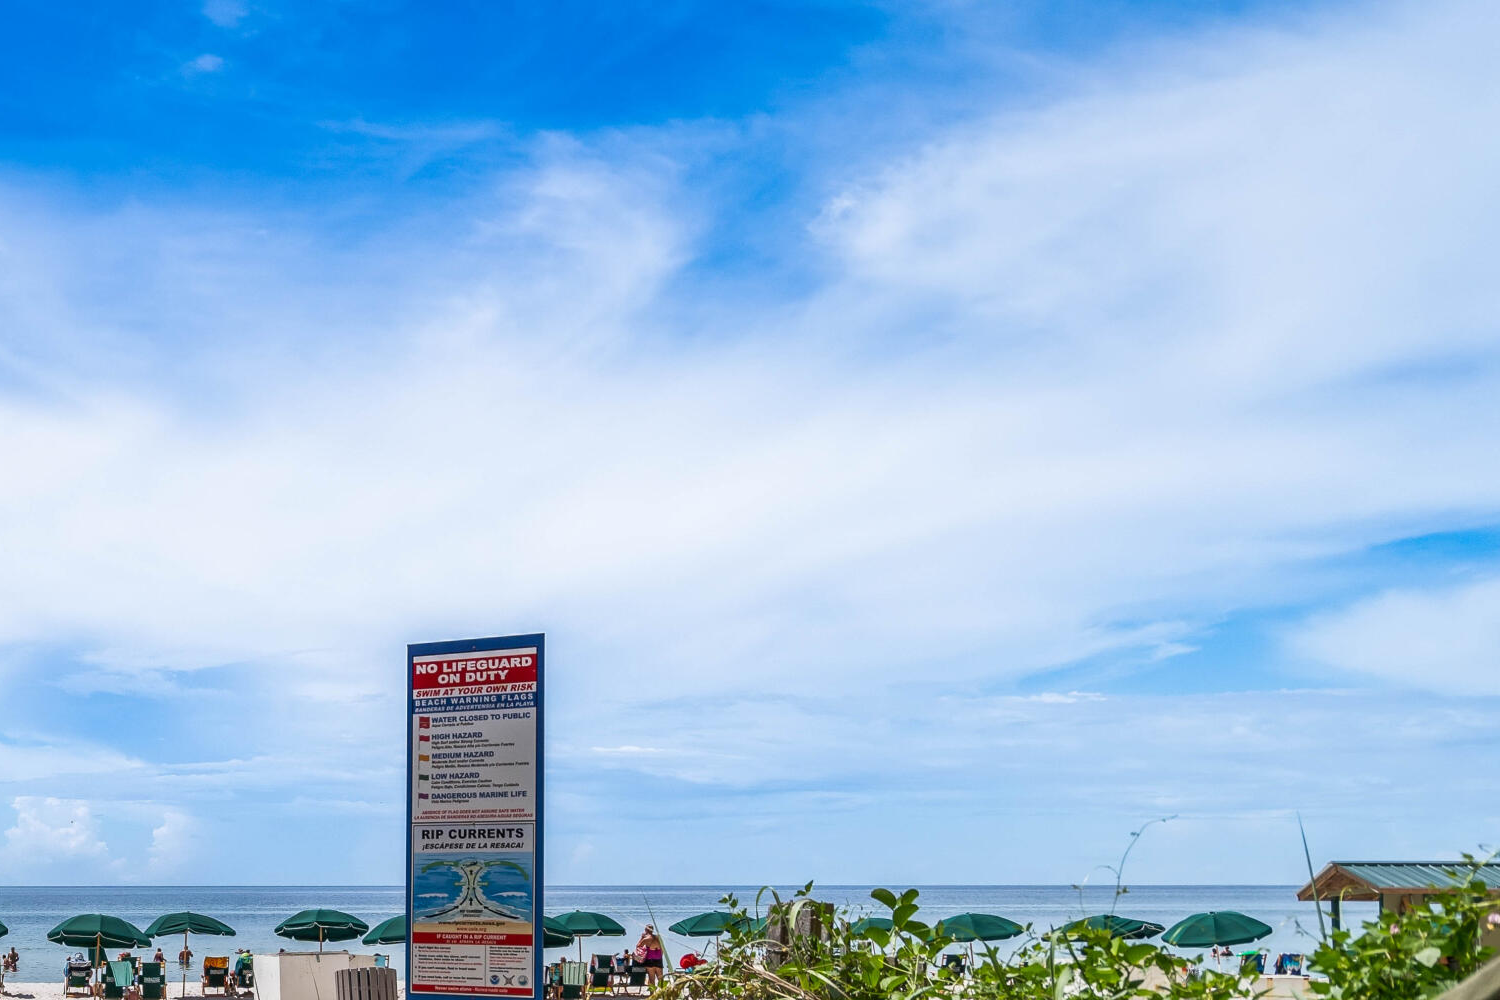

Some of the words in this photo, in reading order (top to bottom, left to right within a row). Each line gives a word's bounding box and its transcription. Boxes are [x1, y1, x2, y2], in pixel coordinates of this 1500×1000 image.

[415, 663, 438, 675] NO
[442, 656, 533, 673] LIFEGUARD
[437, 674, 460, 684] ON
[465, 670, 509, 682] DUTY
[415, 689, 441, 698] SWIM
[442, 688, 456, 697] AT
[459, 687, 483, 695] YOUR
[485, 685, 509, 694] OWN
[510, 683, 534, 692] RISK
[415, 698, 447, 707] BEACH
[451, 695, 497, 705] WARNING
[501, 693, 534, 701] FLAGS
[431, 716, 458, 724] WATER
[459, 714, 489, 722] CLOSED
[502, 712, 531, 720] PUBLIC
[431, 733, 451, 741] HIGH
[452, 731, 483, 740] HAZARD
[431, 752, 462, 760] MEDIUM
[463, 751, 494, 759] HAZARD
[449, 772, 480, 780] HAZARD
[431, 791, 477, 800] DANGEROUS
[478, 791, 509, 799] MARINE
[510, 790, 528, 798] LIFE
[421, 829, 444, 840] RIP
[448, 828, 525, 840] CURRENTS
[465, 842, 477, 850] DE
[490, 842, 525, 850] RESACA!
